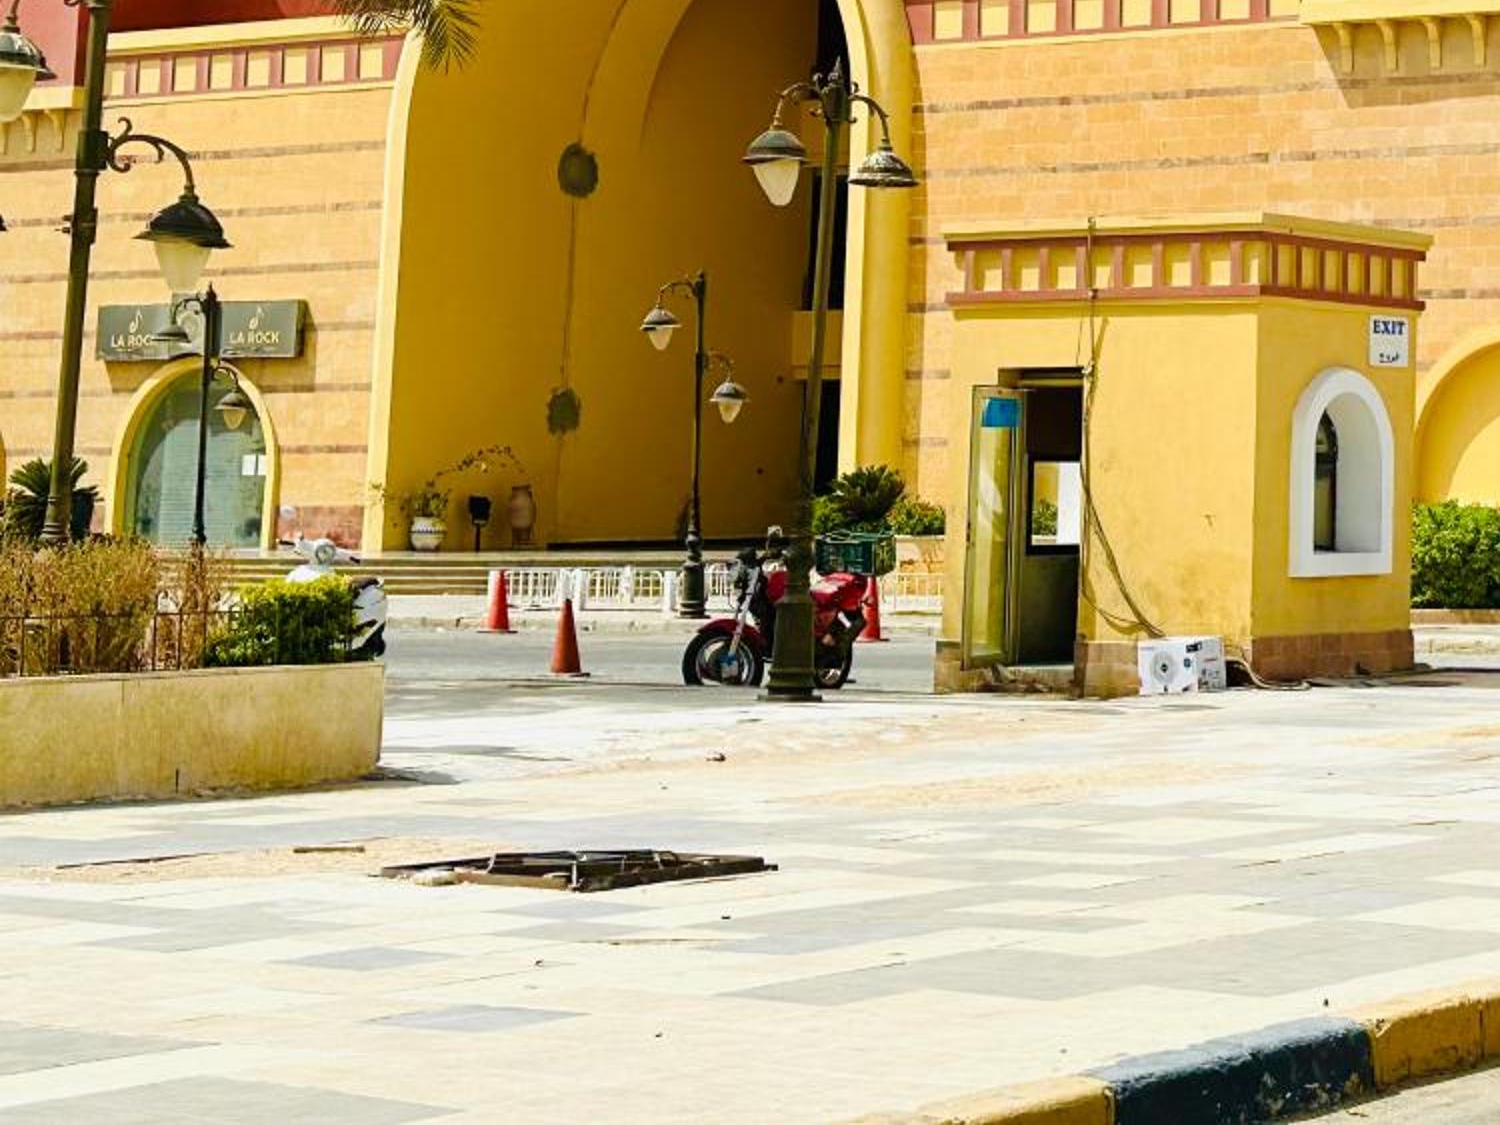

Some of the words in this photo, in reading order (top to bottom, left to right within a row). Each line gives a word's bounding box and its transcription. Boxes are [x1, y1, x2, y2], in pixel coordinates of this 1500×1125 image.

[1373, 320, 1405, 336] EXIT
[111, 334, 125, 348] LA
[127, 333, 153, 347] ROC
[229, 331, 245, 344] LA
[247, 330, 280, 344] ROCK
